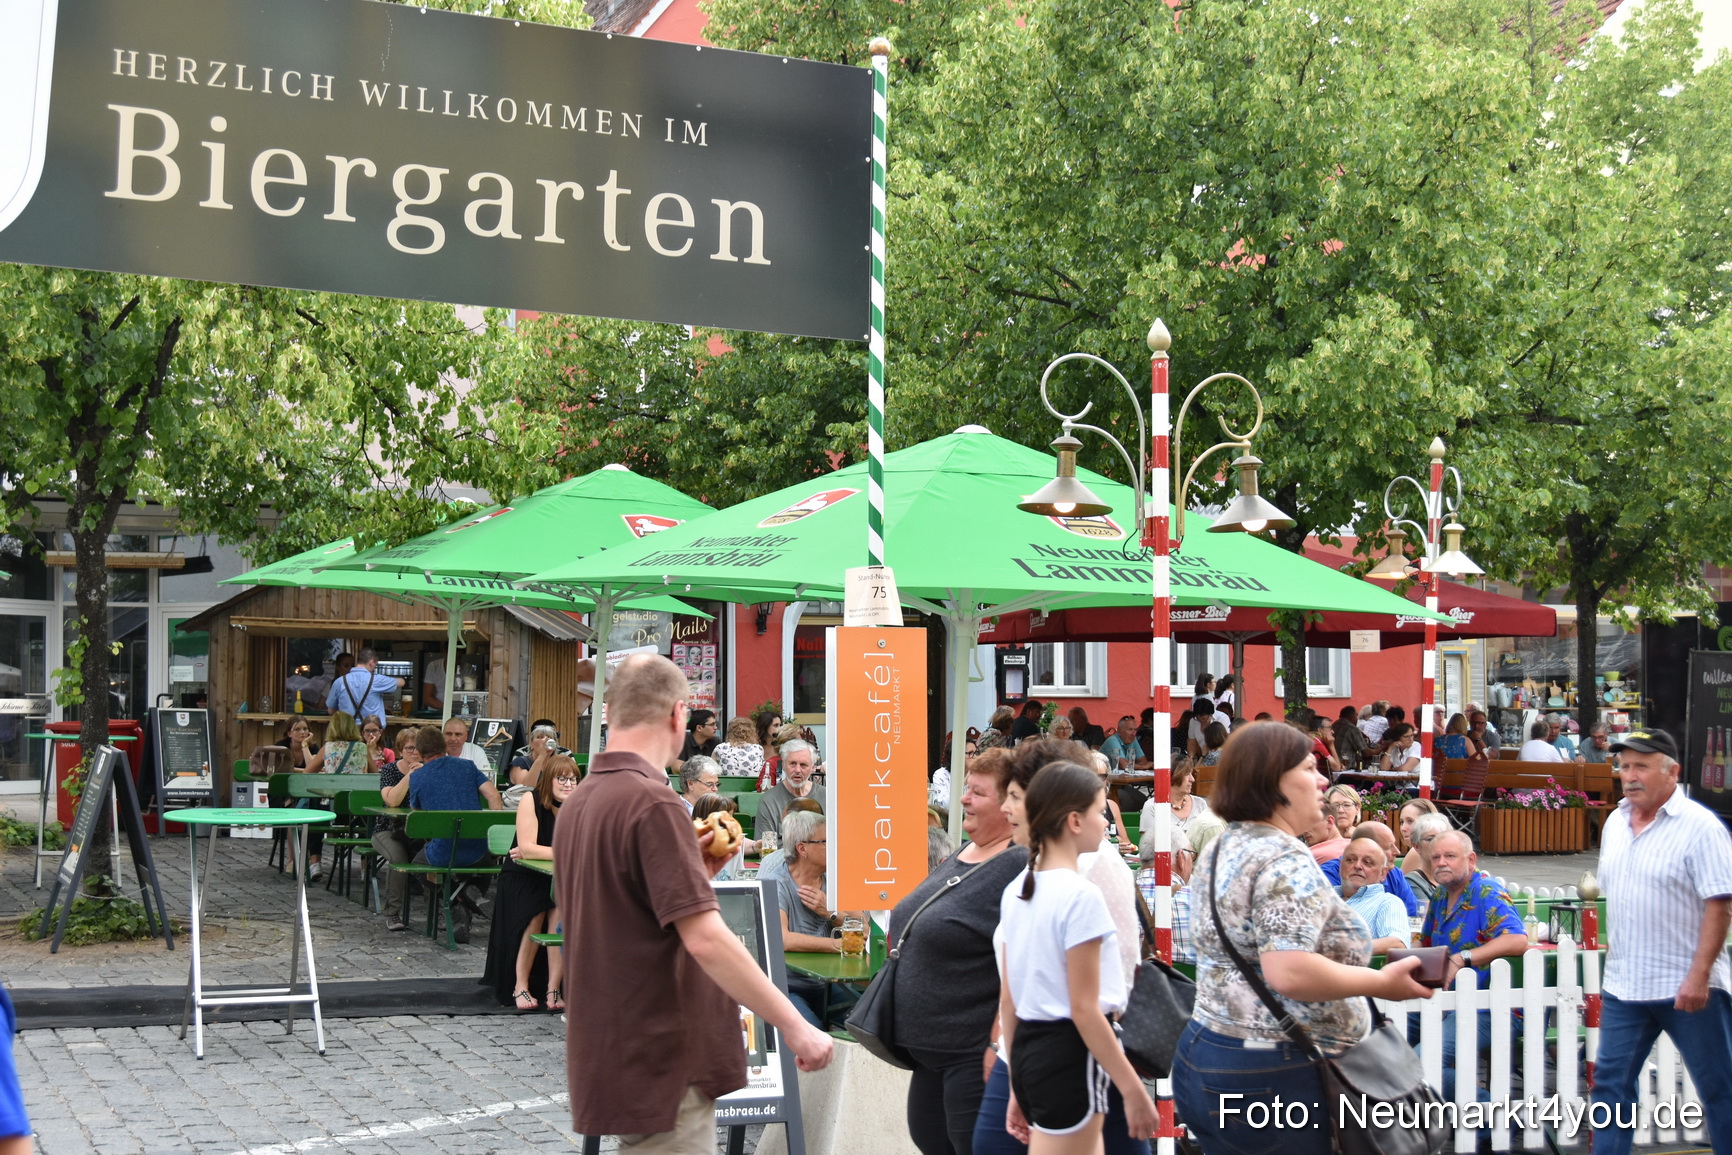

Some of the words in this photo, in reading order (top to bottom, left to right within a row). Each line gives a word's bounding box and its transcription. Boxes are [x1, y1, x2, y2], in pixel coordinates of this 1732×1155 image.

[112, 48, 335, 101] HERZLICH
[359, 79, 643, 138] WILLKOMMEN
[664, 117, 709, 146] IM
[104, 103, 771, 266] Biergarten
[1082, 527, 1113, 538] 1628
[682, 534, 798, 549] Neumarkter
[627, 548, 783, 567] Lammsbräu
[1028, 543, 1211, 568] Neumarter
[871, 586, 887, 599] 75
[613, 611, 658, 623] gelstudio
[631, 629, 661, 648] Pro
[665, 617, 708, 640] Nails
[796, 637, 826, 651] Nail
[1703, 669, 1732, 684] willko
[1717, 688, 1732, 699] NEU
[893, 666, 901, 744] NEUMARKT
[1719, 702, 1732, 714] LIM
[714, 1104, 776, 1118] msbraeu.de
